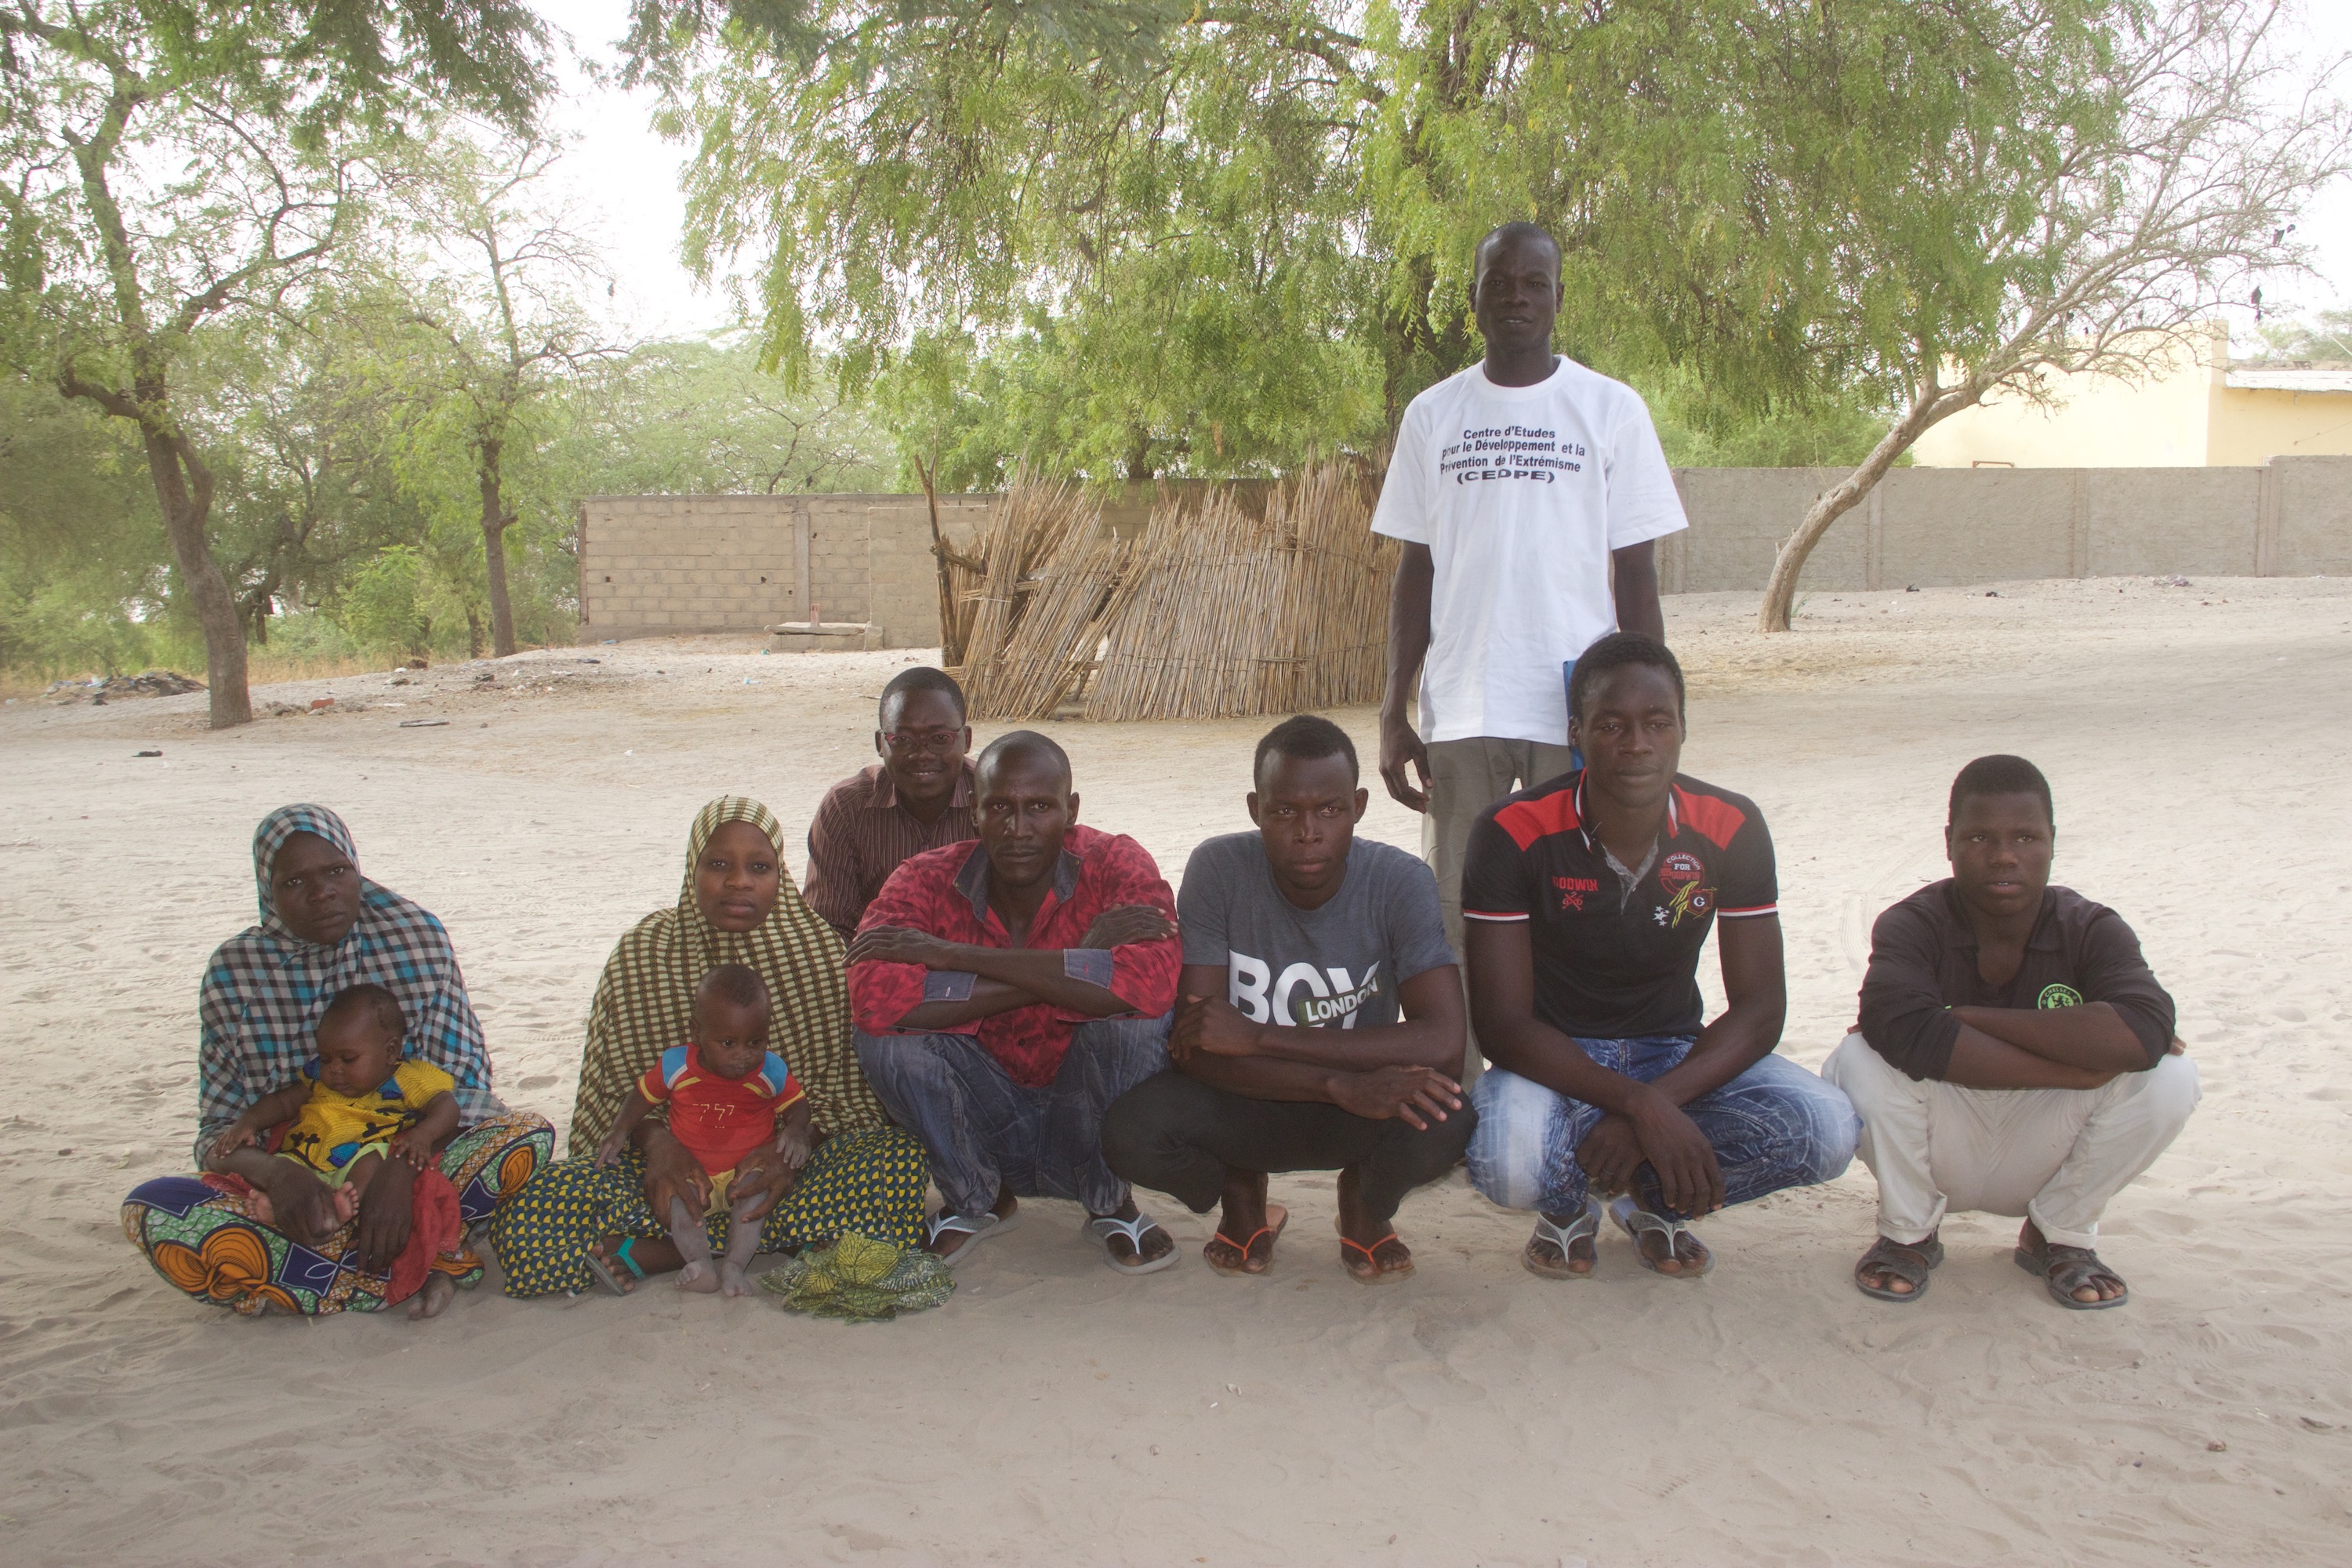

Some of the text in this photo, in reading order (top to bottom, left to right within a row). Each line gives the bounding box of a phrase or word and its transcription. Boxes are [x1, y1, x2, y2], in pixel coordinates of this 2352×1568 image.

[1463, 426, 1555, 440] Centre d'Etudes
[1443, 438, 1585, 461] pour le Développement et la
[1495, 456, 1506, 466] de
[1509, 454, 1581, 472] l'Extrémisme
[1457, 469, 1555, 485] (CEDPE)
[1666, 854, 1701, 871] COLLECTION
[1693, 896, 1705, 907] G
[1229, 949, 1380, 1030] BOY
[2045, 987, 2071, 997] CHELSEA
[1305, 978, 1378, 1022] LONDON
